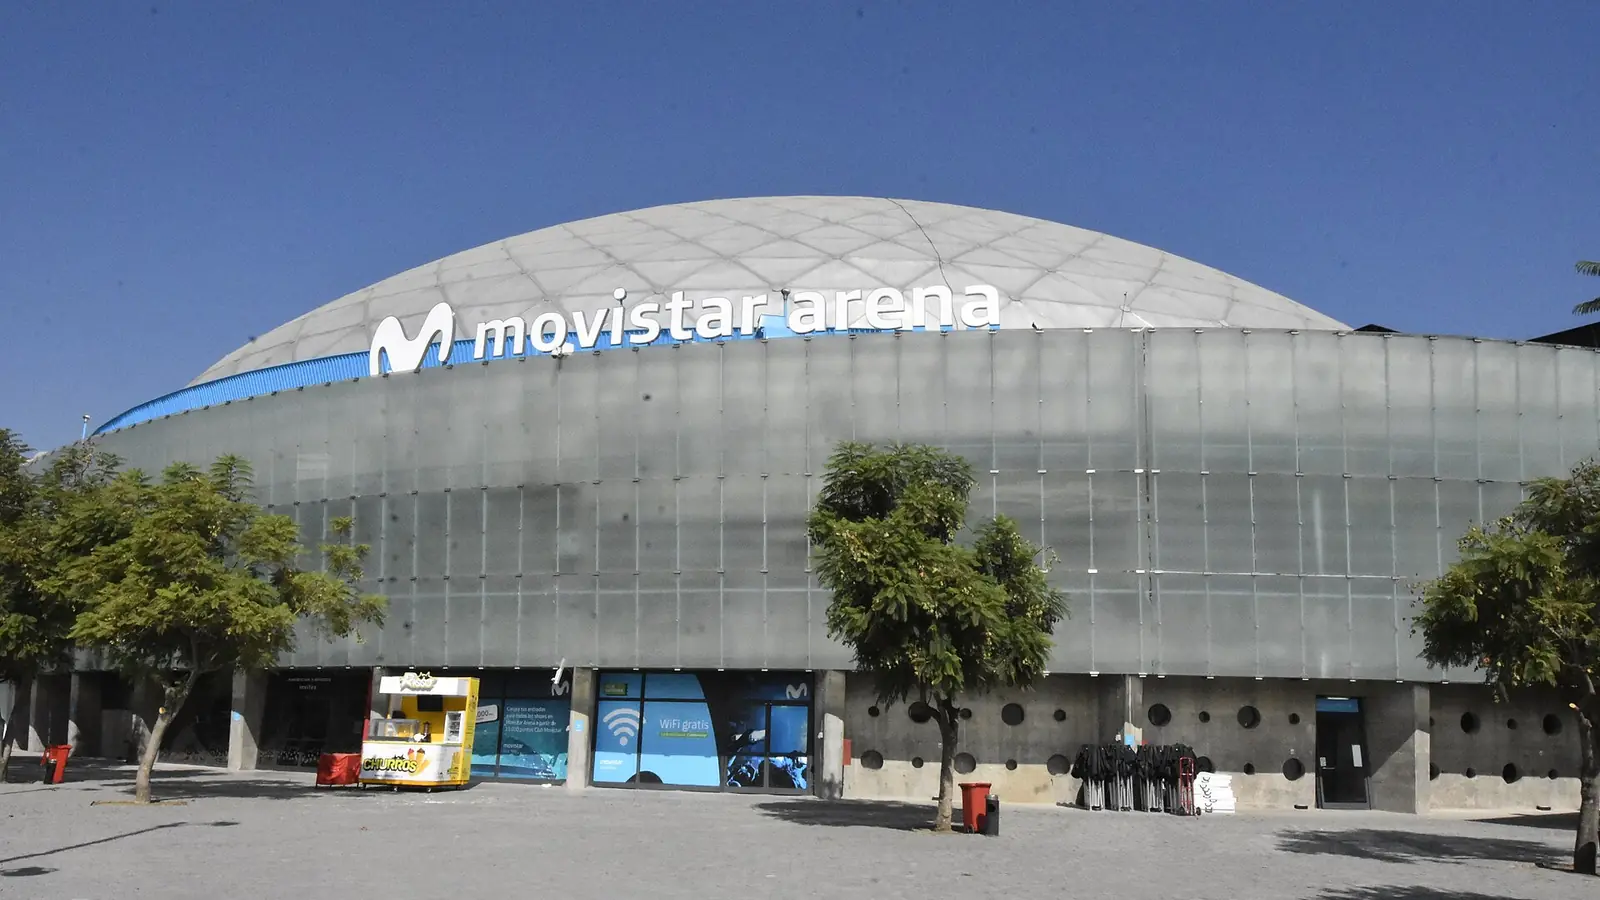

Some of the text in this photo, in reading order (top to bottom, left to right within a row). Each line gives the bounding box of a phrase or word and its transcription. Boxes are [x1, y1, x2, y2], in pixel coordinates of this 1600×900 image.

[473, 287, 767, 358] movistar
[788, 284, 1000, 333] arena
[660, 719, 709, 732] WiFi gratis
[363, 757, 417, 773] CHURROS
